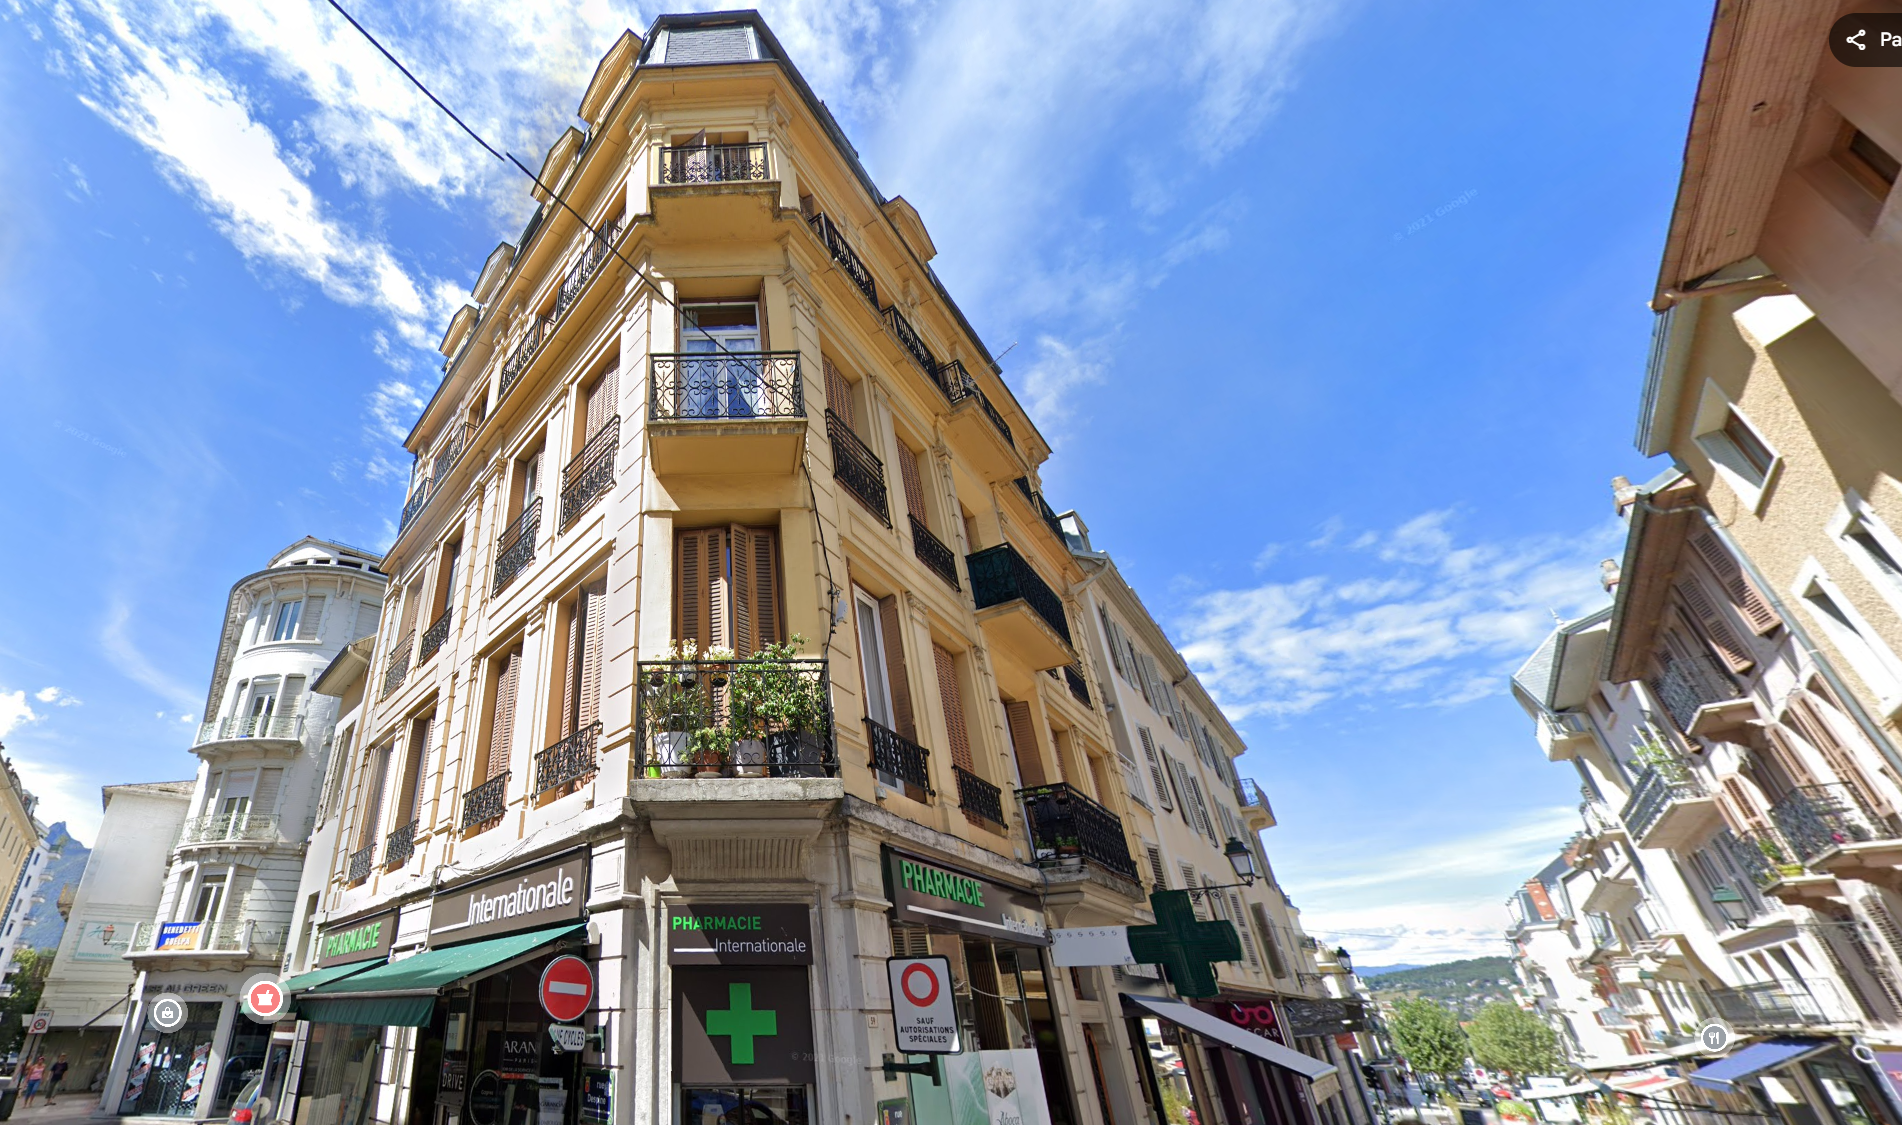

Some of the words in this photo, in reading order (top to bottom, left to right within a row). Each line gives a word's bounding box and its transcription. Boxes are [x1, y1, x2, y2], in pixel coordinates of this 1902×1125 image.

[901, 860, 985, 907] PHARMACIE
[470, 867, 574, 926] Internationale
[672, 916, 762, 930] PHARMACIE
[163, 925, 200, 935] BENEDETTI
[325, 921, 382, 958] PHARMACIE
[714, 937, 806, 953] Internationale
[183, 983, 228, 993] GREEN
[916, 1017, 934, 1025] SAUF
[900, 1026, 954, 1034] AUTORISATIONS
[564, 1030, 585, 1046] CYCLES
[909, 1034, 947, 1043] SPÉCIALES
[442, 1073, 463, 1090] DRIVE
[597, 1081, 605, 1090] rue
[894, 1110, 903, 1119] rue
